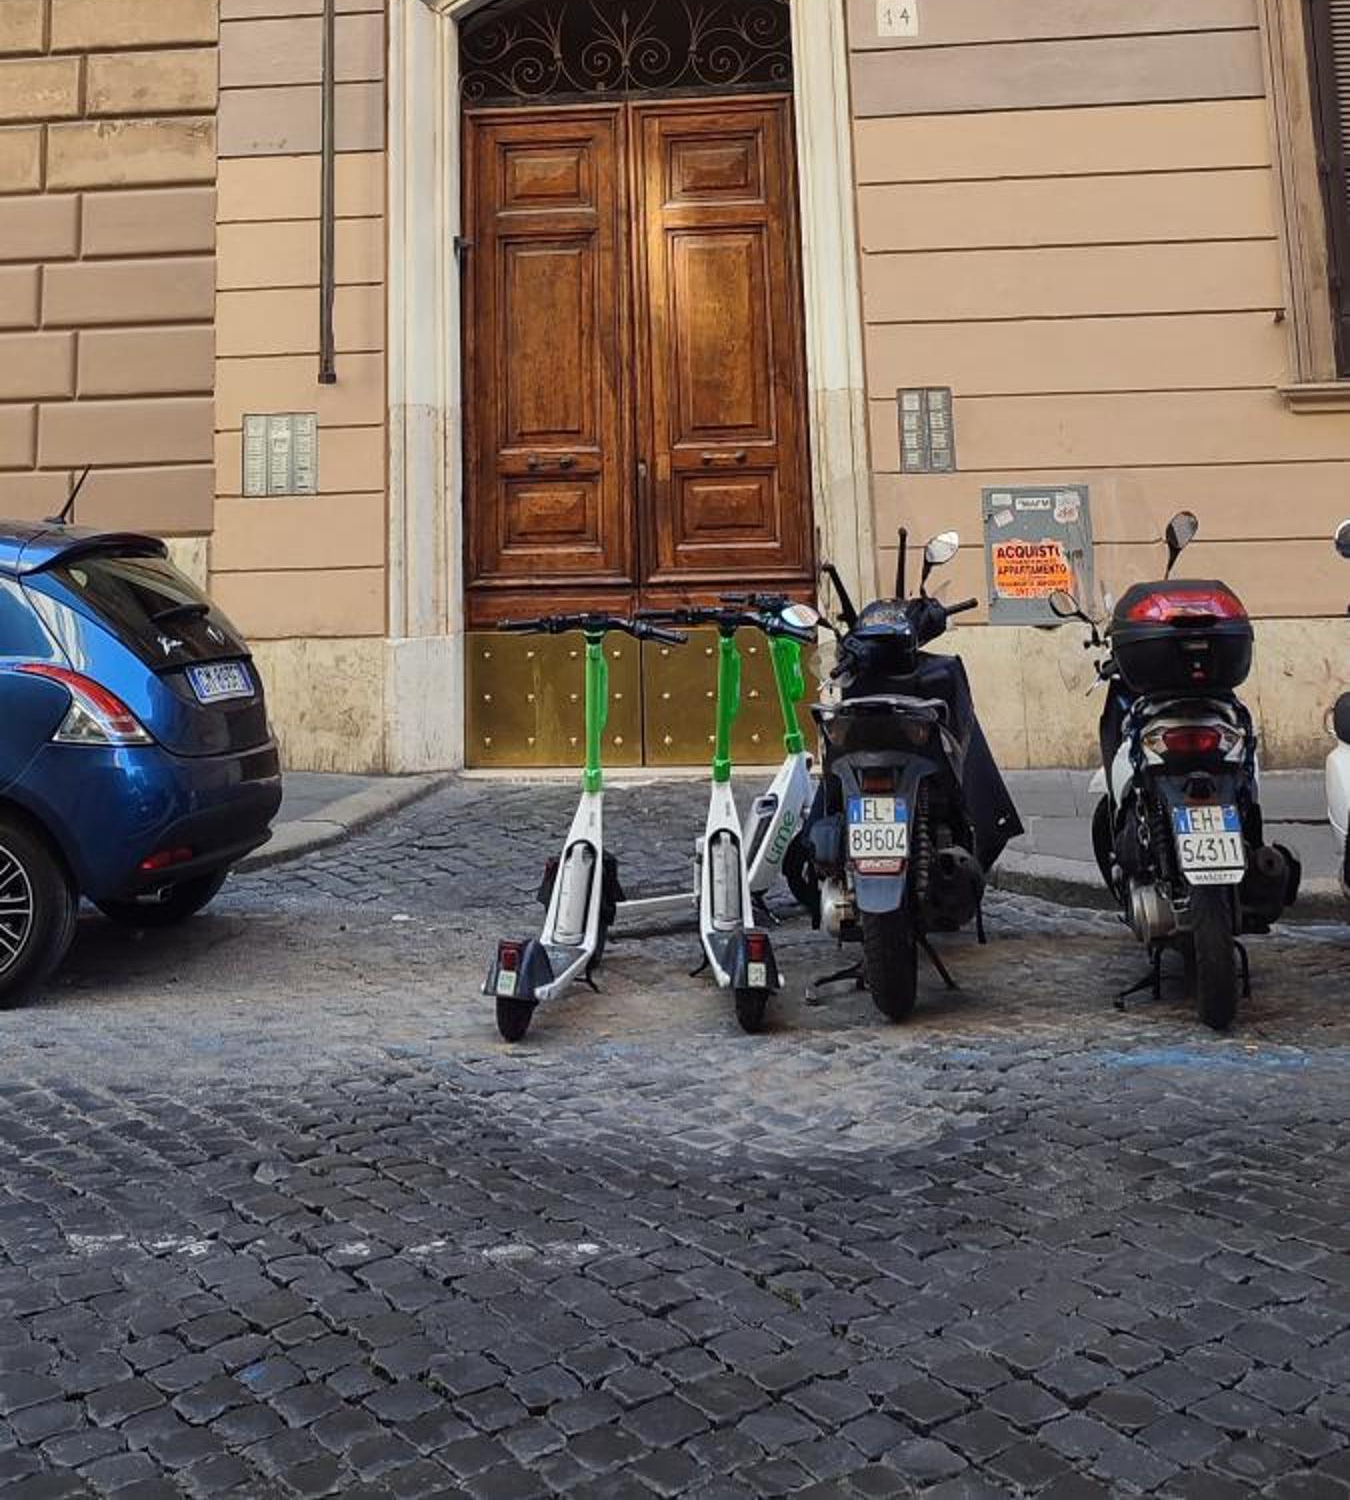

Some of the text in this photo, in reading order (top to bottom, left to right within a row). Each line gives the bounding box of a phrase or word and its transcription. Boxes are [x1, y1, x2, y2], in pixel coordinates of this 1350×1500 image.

[883, 8, 910, 26] 14
[997, 564, 1067, 575] APPARTAMENTO
[864, 799, 884, 820] EL
[1190, 808, 1213, 830] EH
[851, 827, 905, 852] 89604
[1183, 838, 1239, 863] 54311
